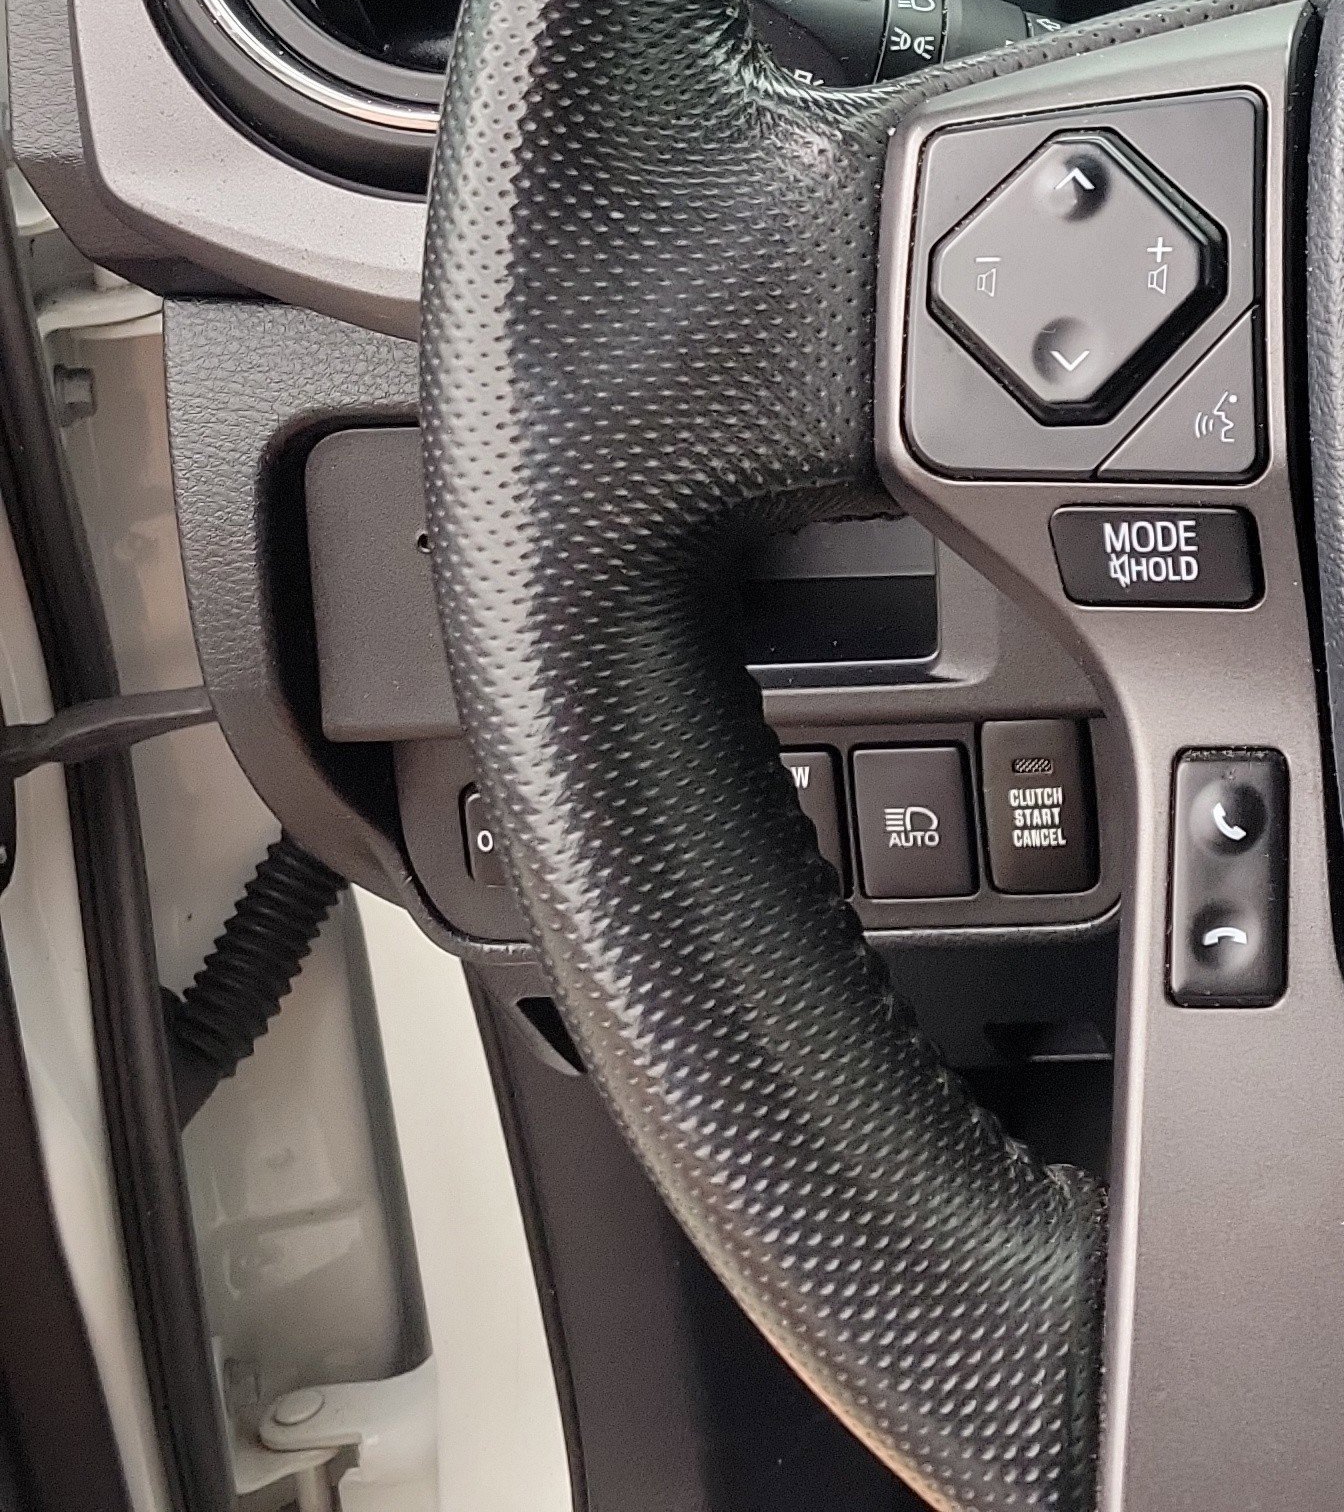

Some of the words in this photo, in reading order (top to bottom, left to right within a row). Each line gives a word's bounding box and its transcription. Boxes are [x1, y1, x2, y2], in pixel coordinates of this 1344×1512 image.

[1103, 519, 1198, 553] MODE
[1131, 555, 1199, 582] HOLD
[1009, 787, 1063, 809] CLUTCH
[1014, 807, 1061, 827] START
[888, 830, 940, 848] AUTO
[1012, 825, 1067, 848] CANCEL
